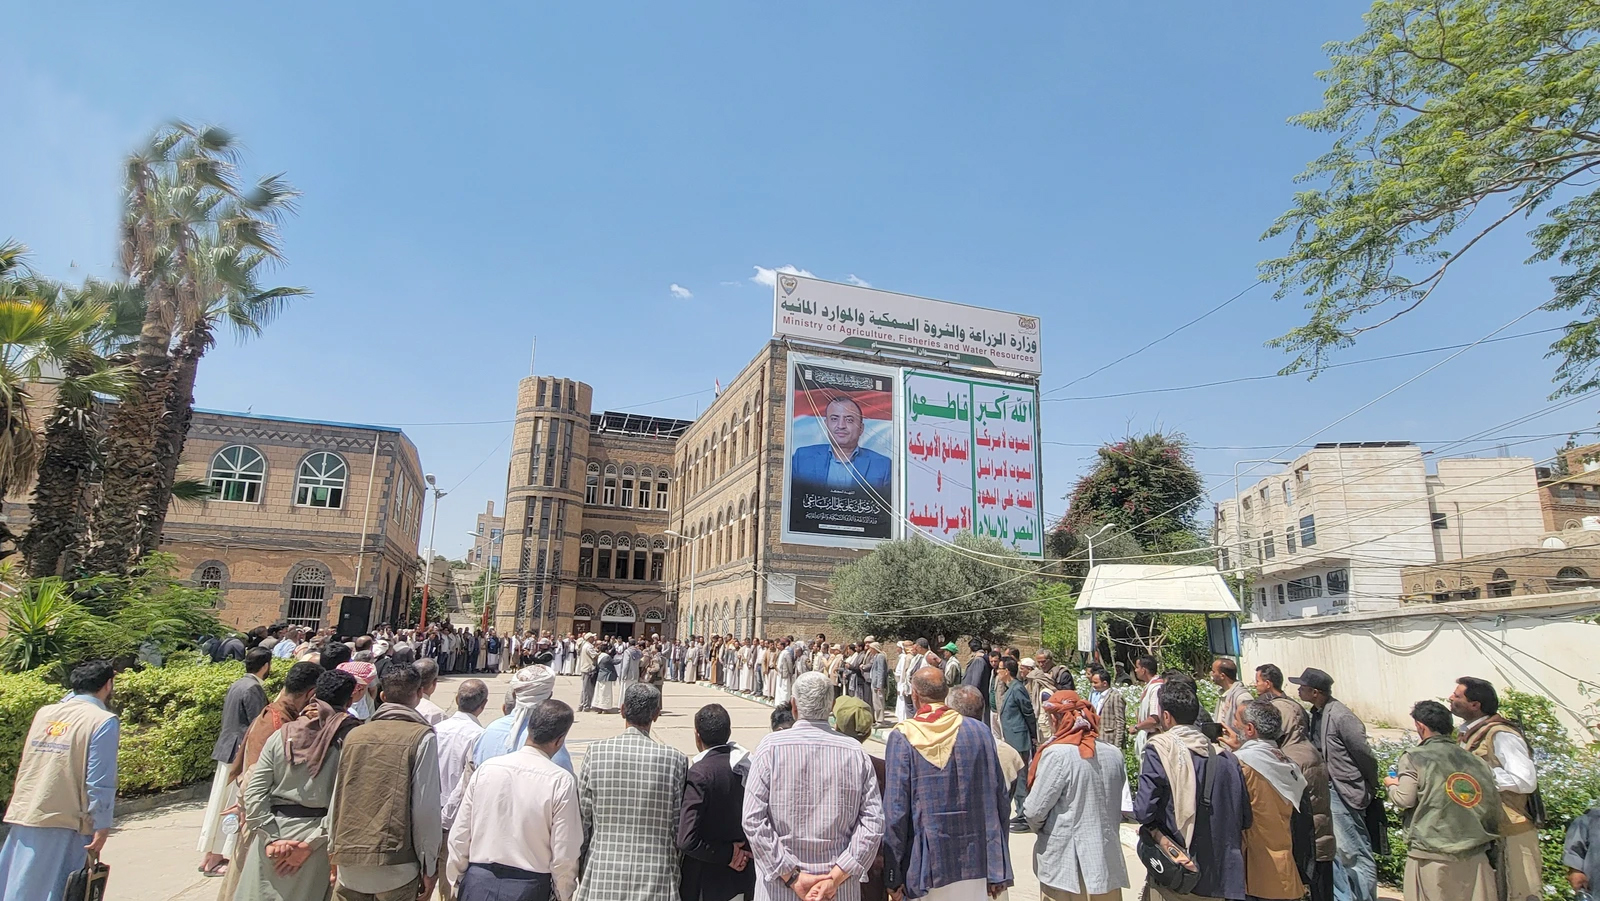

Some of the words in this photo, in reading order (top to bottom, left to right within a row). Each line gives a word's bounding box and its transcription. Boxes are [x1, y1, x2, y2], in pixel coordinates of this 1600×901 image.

[780, 295, 817, 316] المائية
[821, 304, 865, 327] والموارد
[869, 310, 920, 332] السمكية
[923, 319, 966, 343] والثروة
[782, 315, 824, 332] Ministry
[826, 323, 837, 332] of
[898, 334, 941, 348] Fisheries
[943, 343, 960, 353] and
[962, 344, 988, 356] Water
[990, 349, 1034, 363] Resources
[969, 326, 1006, 347] الزراعة
[1010, 334, 1037, 354] وزارة
[908, 385, 969, 422] قاطعوا
[975, 390, 1010, 427] أكبر
[1010, 396, 1033, 423] الله
[908, 428, 941, 462] الأمريكية
[941, 433, 969, 466] البضائع
[976, 426, 1007, 452] لأمريكا
[1008, 434, 1033, 454] الموت
[936, 469, 942, 493] و
[1009, 462, 1034, 483] الموت
[977, 487, 1000, 510] اليهود
[1016, 489, 1035, 509] اللعنة
[1010, 514, 1037, 545] النصر
